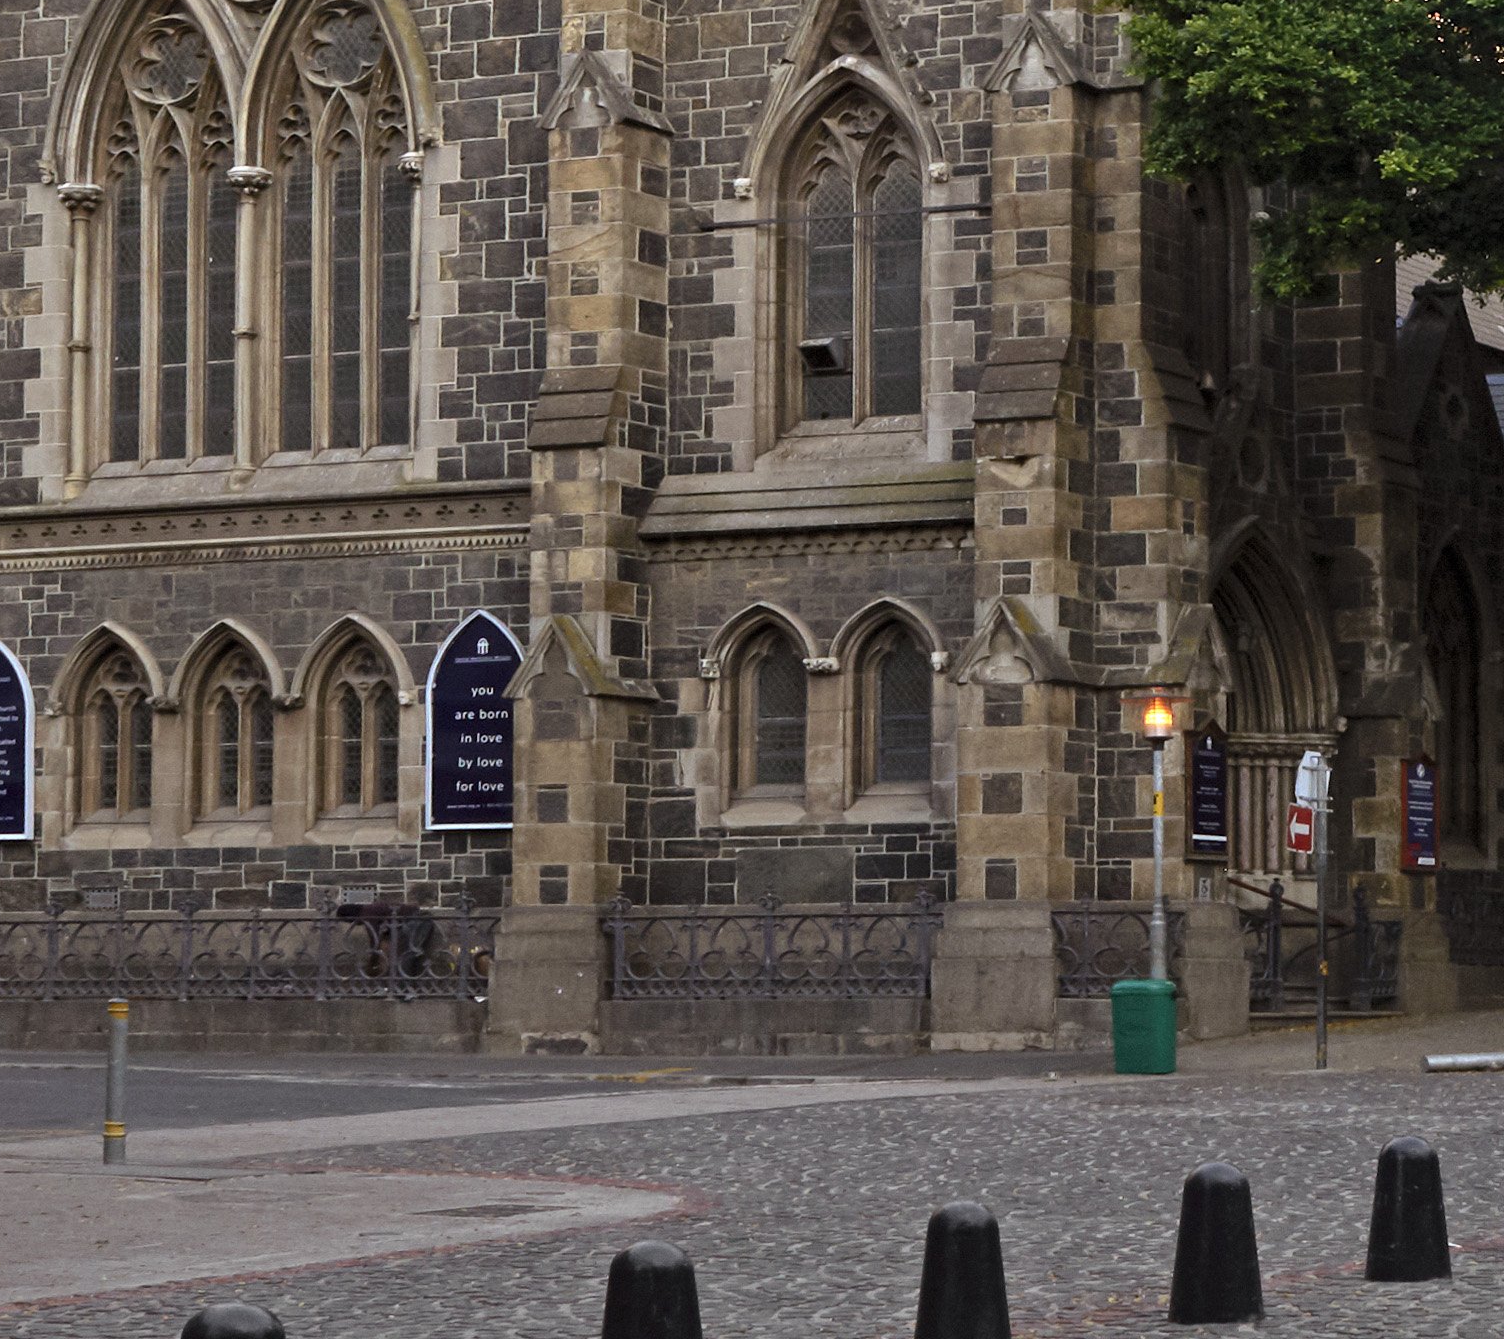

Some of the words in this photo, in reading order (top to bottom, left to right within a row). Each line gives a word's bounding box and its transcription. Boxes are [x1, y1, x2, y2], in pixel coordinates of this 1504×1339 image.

[471, 686, 494, 698] you
[455, 710, 475, 720] are
[479, 708, 509, 720] born
[460, 733, 472, 743] in
[476, 732, 503, 743] love
[458, 756, 473, 769] by
[477, 756, 504, 768] love
[456, 780, 474, 792] for
[478, 780, 505, 792] love
